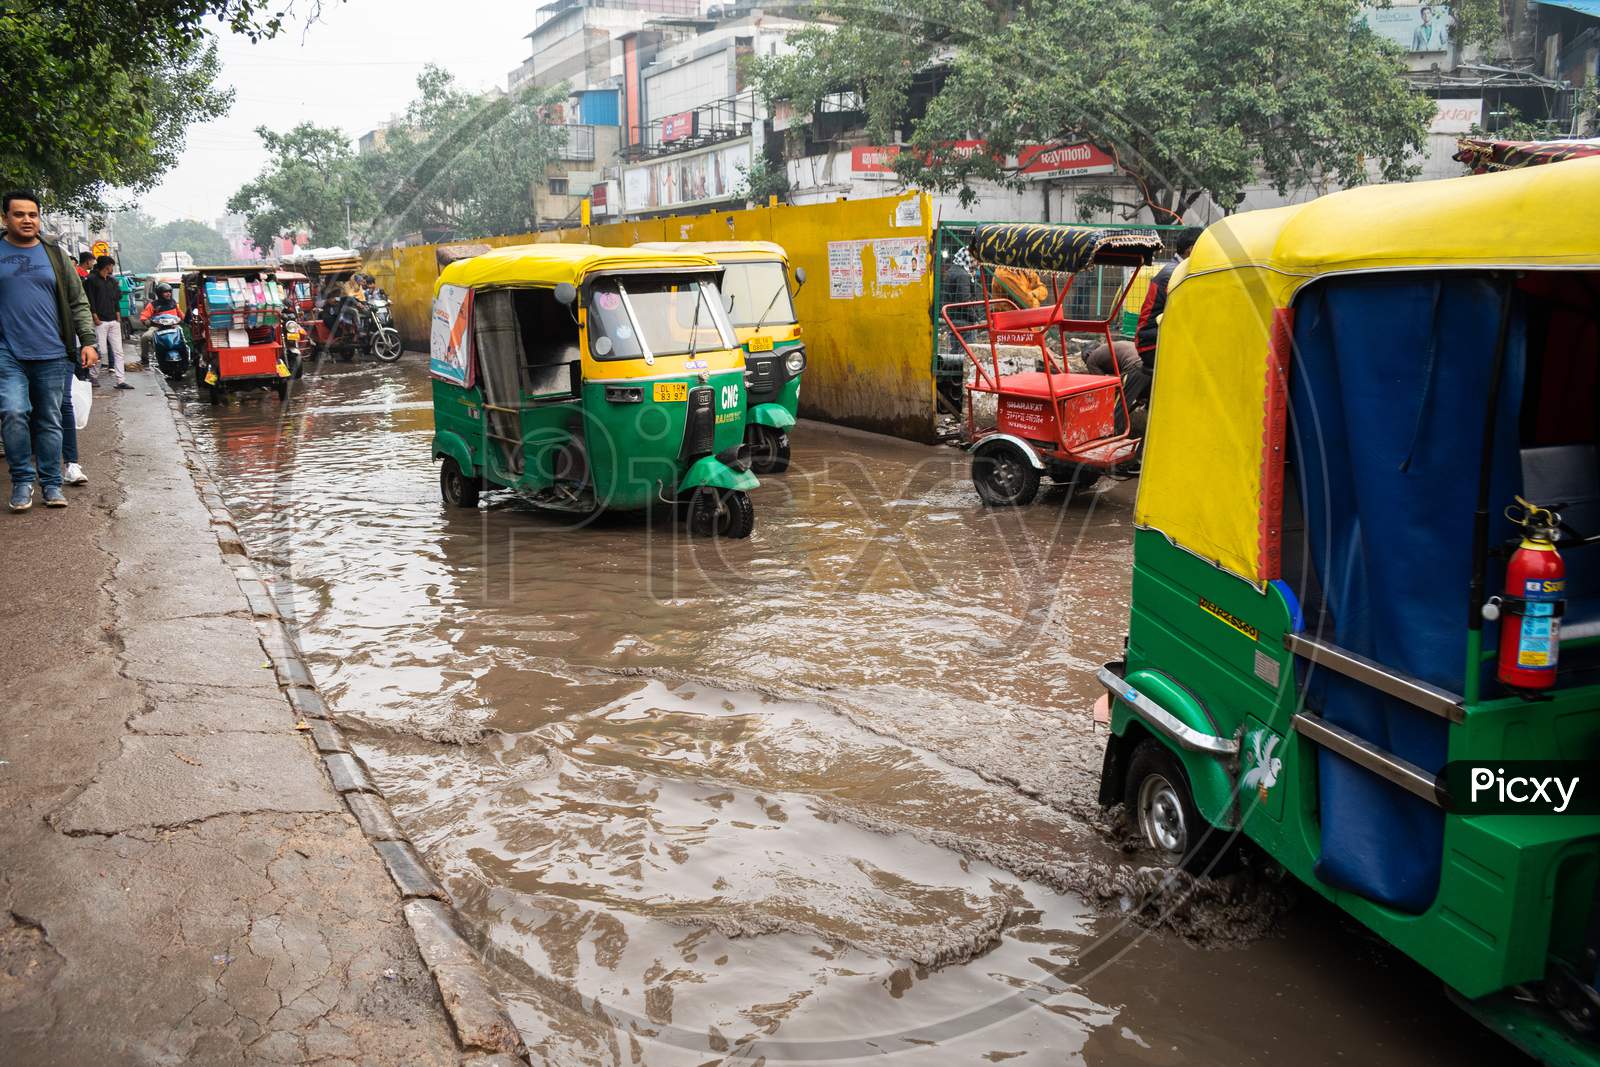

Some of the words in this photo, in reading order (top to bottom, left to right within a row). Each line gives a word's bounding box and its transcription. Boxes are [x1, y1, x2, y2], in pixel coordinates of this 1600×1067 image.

[1041, 144, 1091, 167] Raymond
[996, 333, 1034, 343] SHARAFAT
[661, 384, 669, 393] DL
[721, 383, 739, 410] CNG
